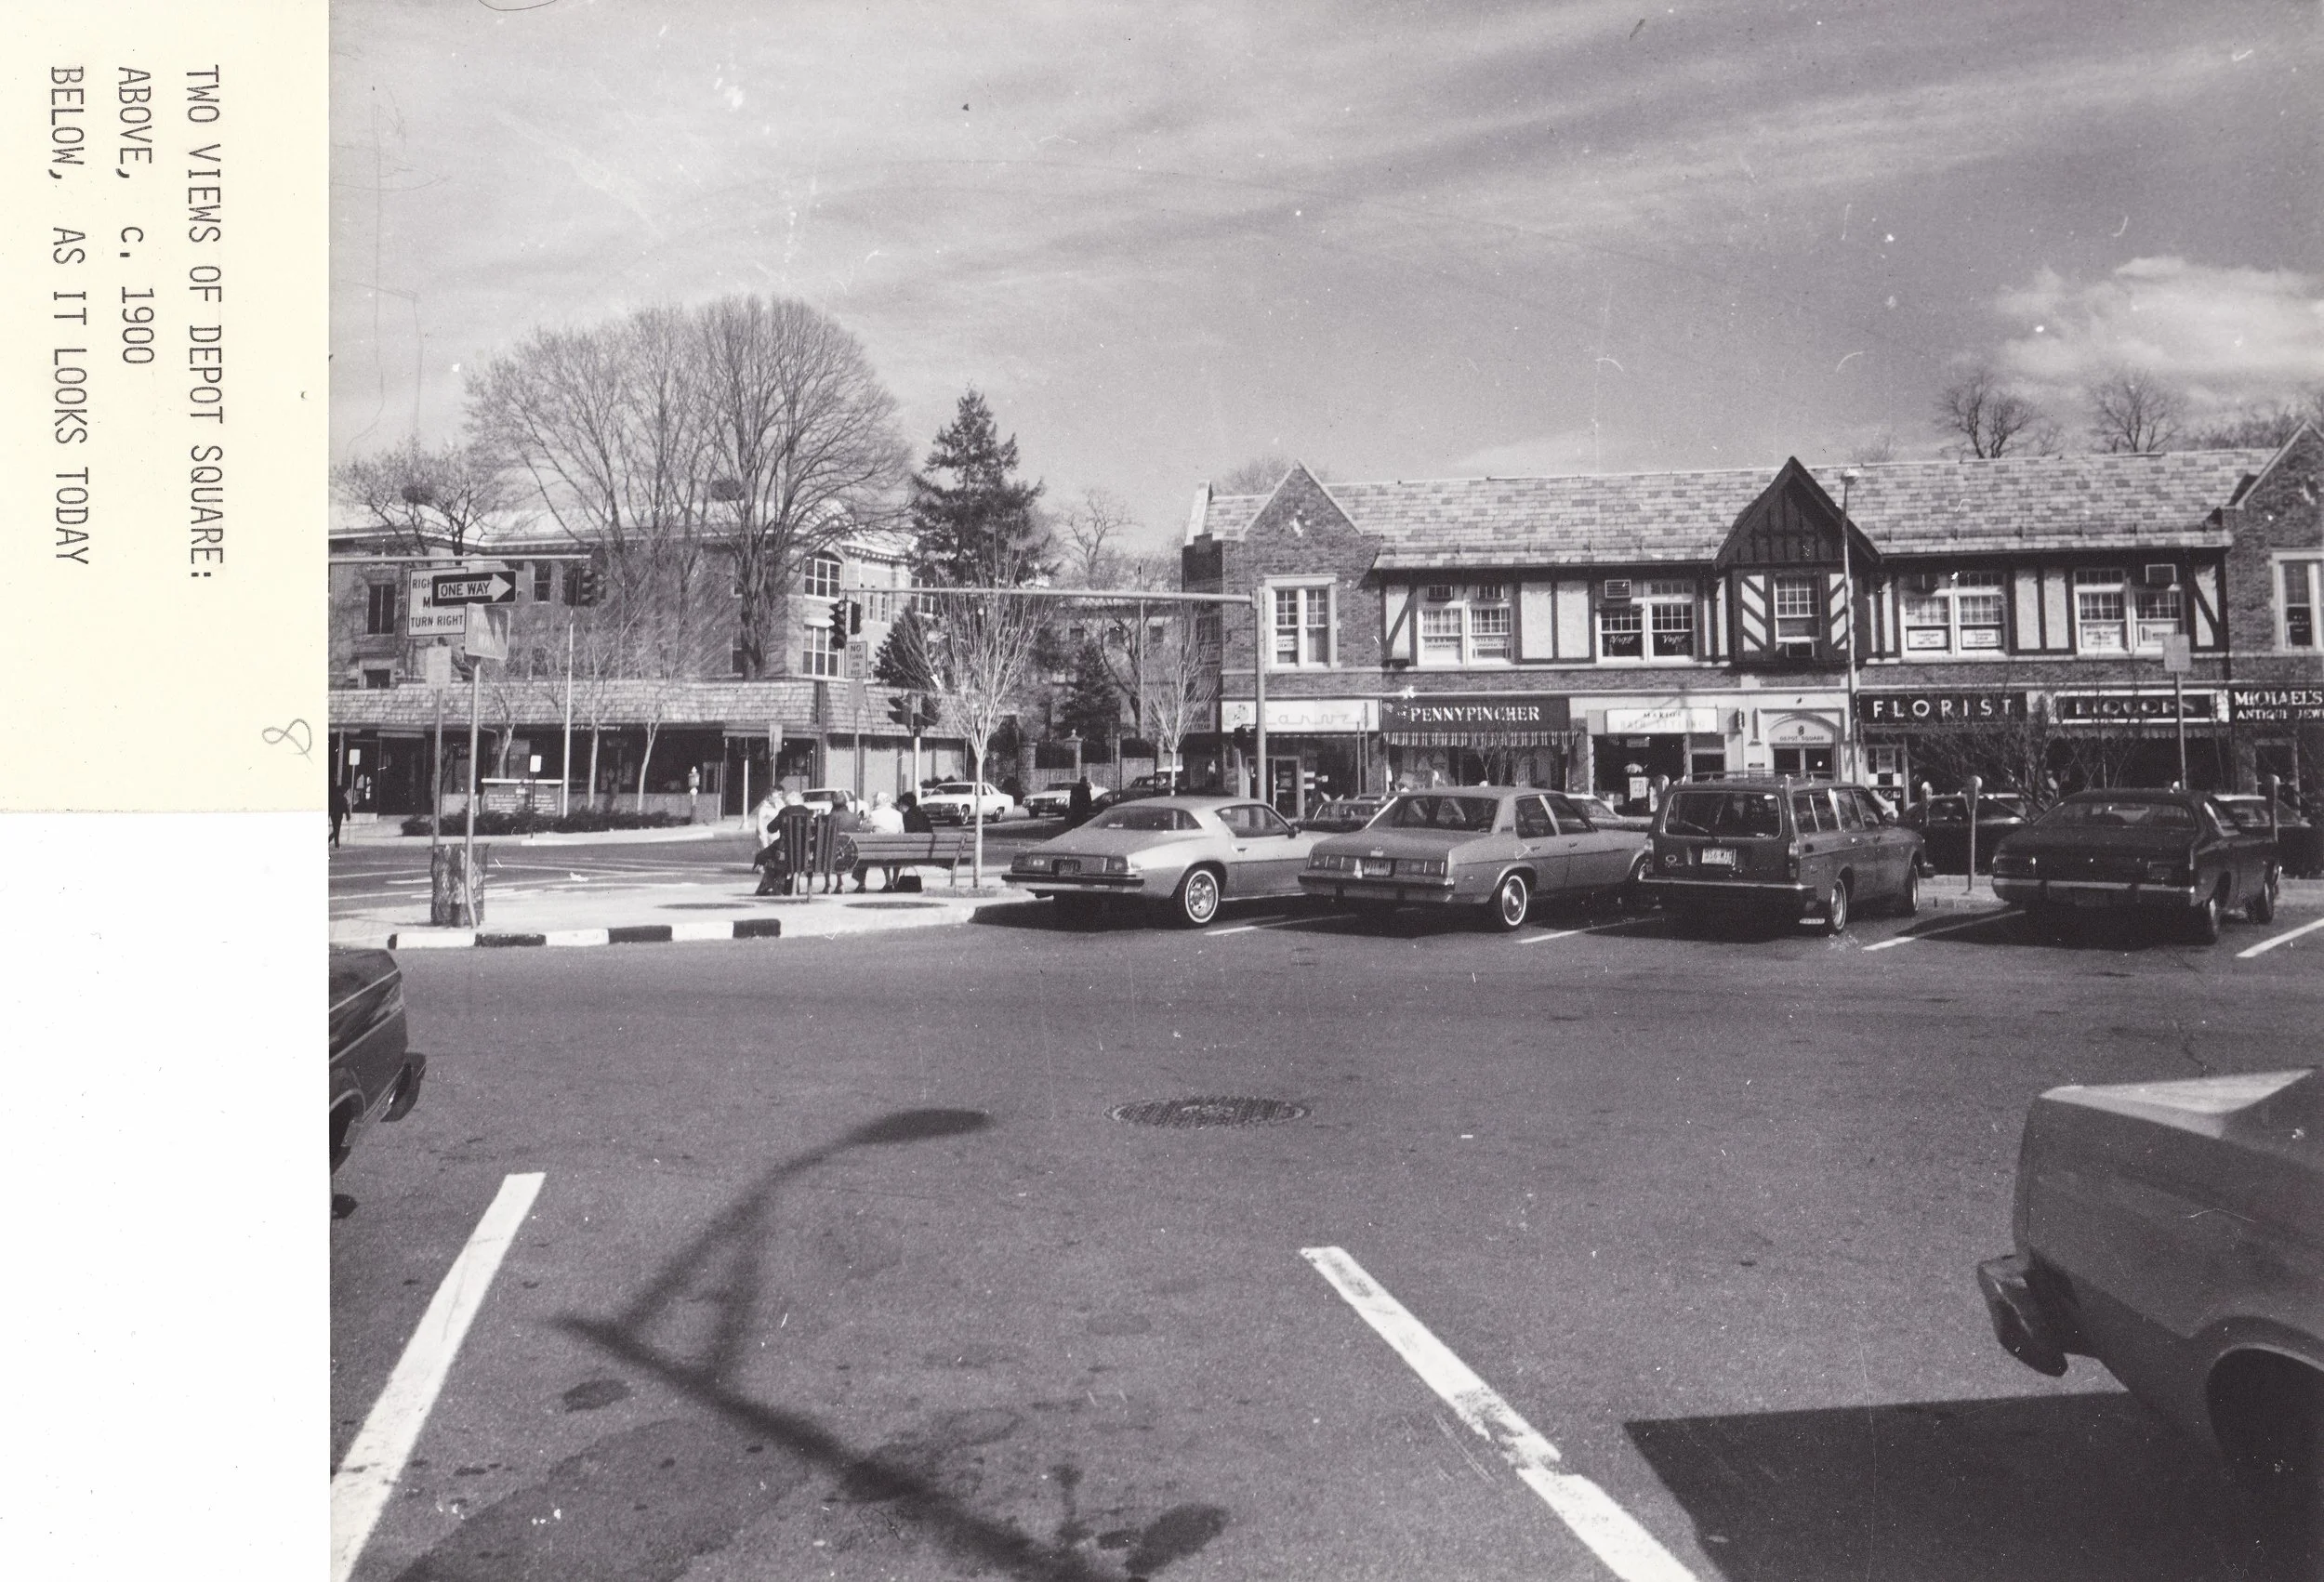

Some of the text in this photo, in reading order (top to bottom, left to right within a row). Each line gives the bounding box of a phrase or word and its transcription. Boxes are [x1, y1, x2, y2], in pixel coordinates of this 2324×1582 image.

[115, 68, 154, 364] ABOVE, c. 1900
[48, 67, 87, 565] BELOW, AS IT LOOKS TODAY
[186, 66, 222, 580] TWO VIEWS OF DEPOT SQUARE:
[412, 578, 432, 589] RIGH
[441, 581, 491, 597] ONE WAY
[411, 616, 434, 628] TURN
[437, 614, 464, 626] RIGHT
[1410, 705, 1541, 722] PENNYPINCHER
[1873, 699, 2013, 718] FLORIST
